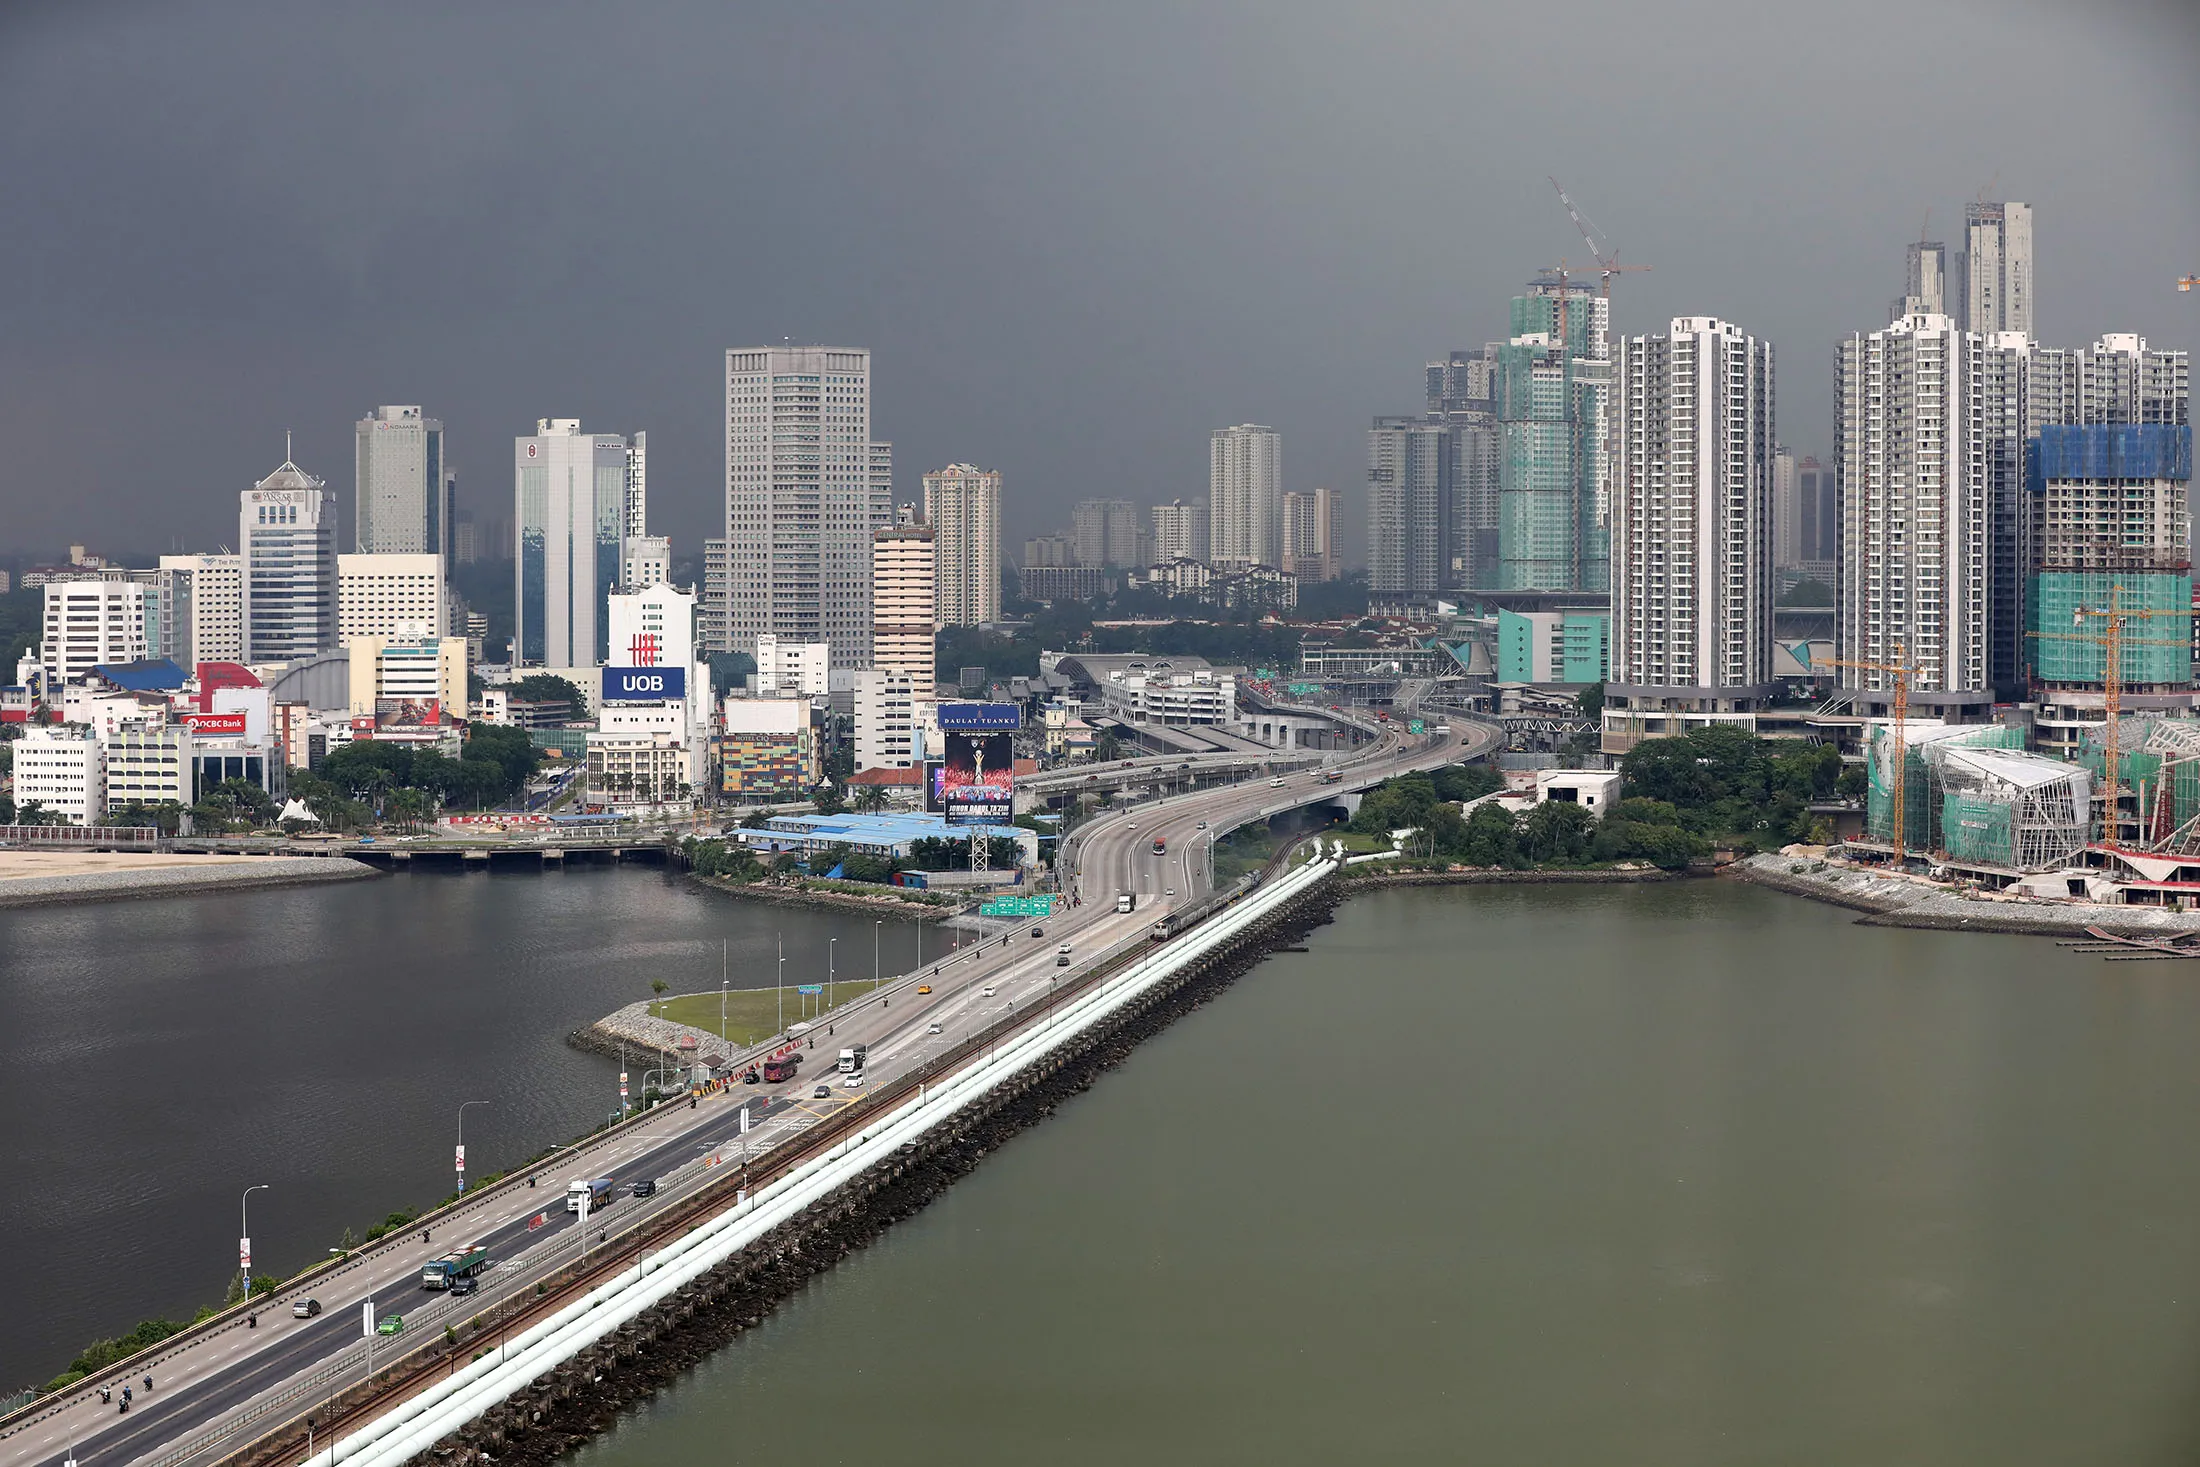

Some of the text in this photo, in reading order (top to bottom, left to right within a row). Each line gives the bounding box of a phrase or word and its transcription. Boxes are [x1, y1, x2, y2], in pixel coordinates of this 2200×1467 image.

[622, 675, 664, 692] UOB
[200, 720, 242, 728] OCBC Bank
